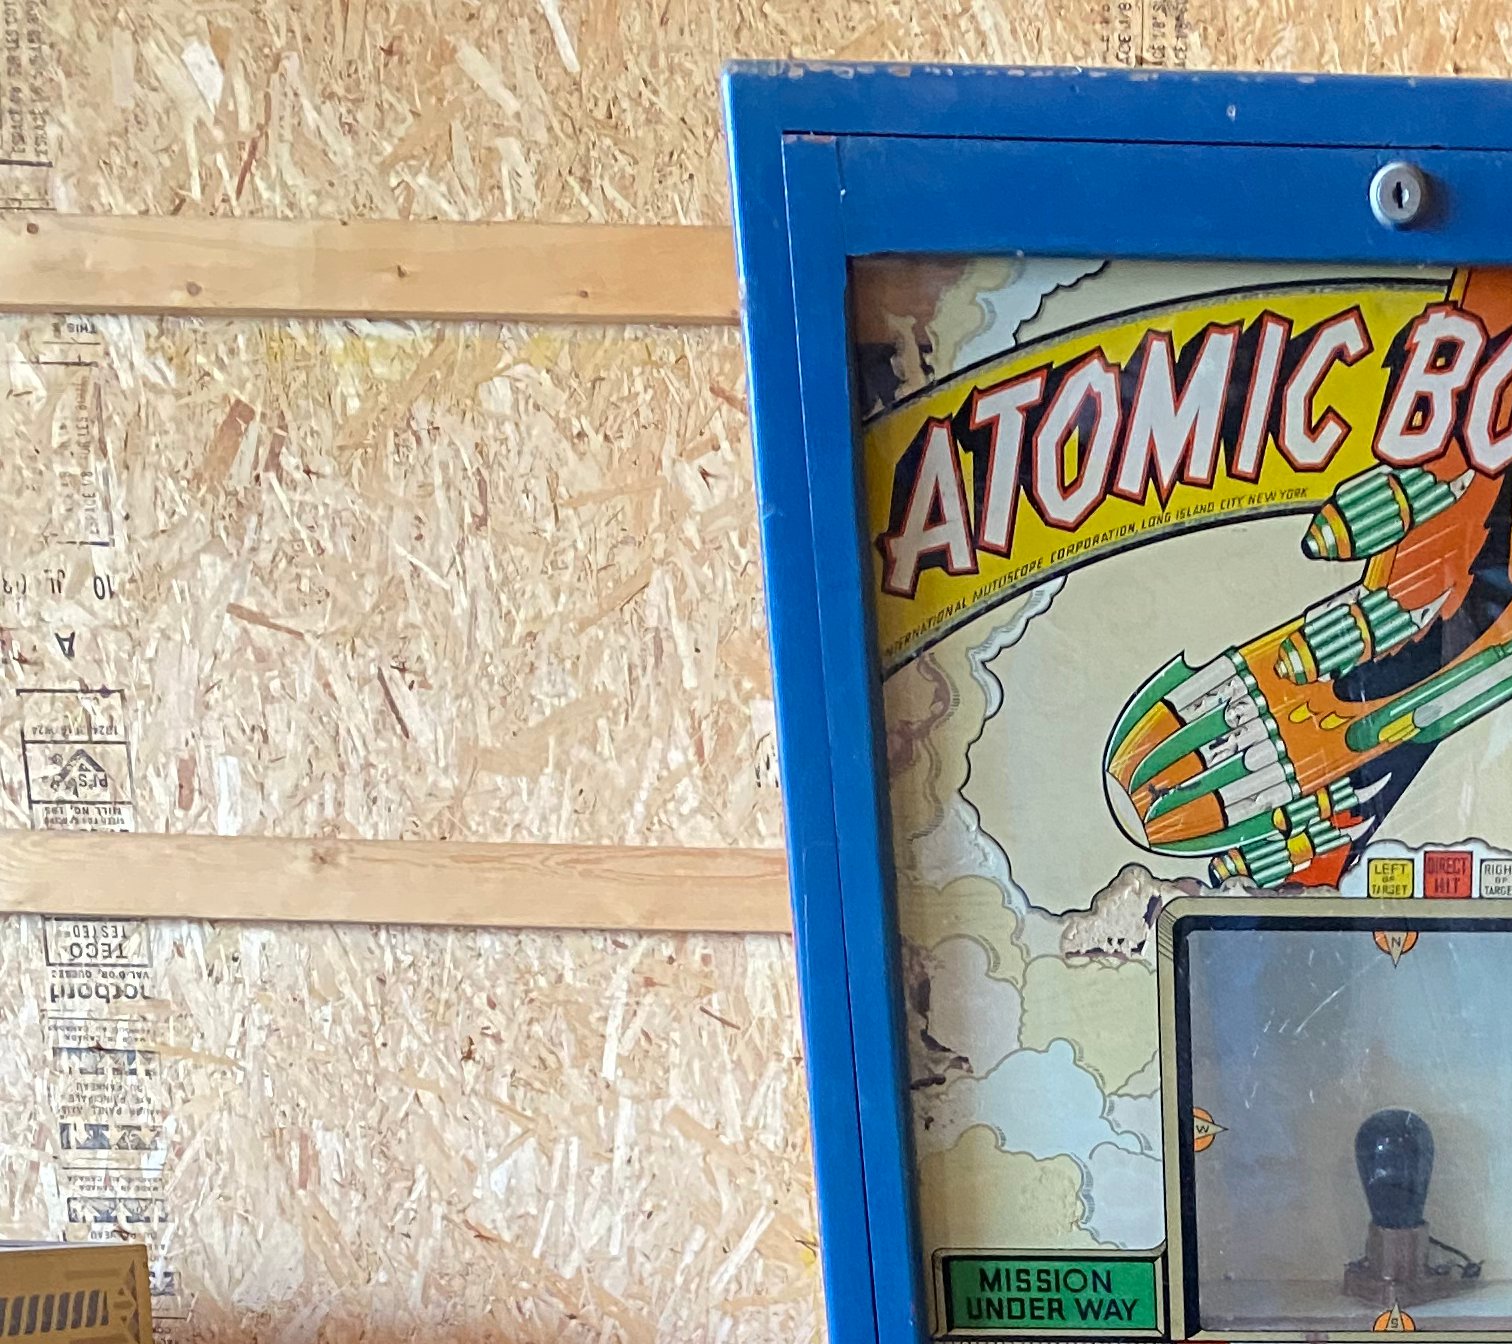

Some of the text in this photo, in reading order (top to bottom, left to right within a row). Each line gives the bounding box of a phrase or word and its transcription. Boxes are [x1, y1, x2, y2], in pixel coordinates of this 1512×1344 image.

[877, 305, 1373, 599] ATOMIC
[972, 557, 1043, 604] MUTOSCOPE
[1141, 513, 1171, 531] LONG
[1175, 500, 1215, 521] ISLAND
[1220, 494, 1243, 512] CITY
[1247, 490, 1277, 507] NEW
[1279, 486, 1310, 502] YORK
[1374, 862, 1407, 875] LEFT
[1426, 857, 1469, 875] DIRECT
[1372, 884, 1408, 896] TARGET
[1434, 877, 1460, 894] HIT
[68, 942, 128, 960] TECO
[1391, 936, 1401, 948] N
[1196, 1124, 1210, 1134] W
[980, 1268, 1113, 1294] MISSION
[966, 1297, 1140, 1322] UNDER WAY
